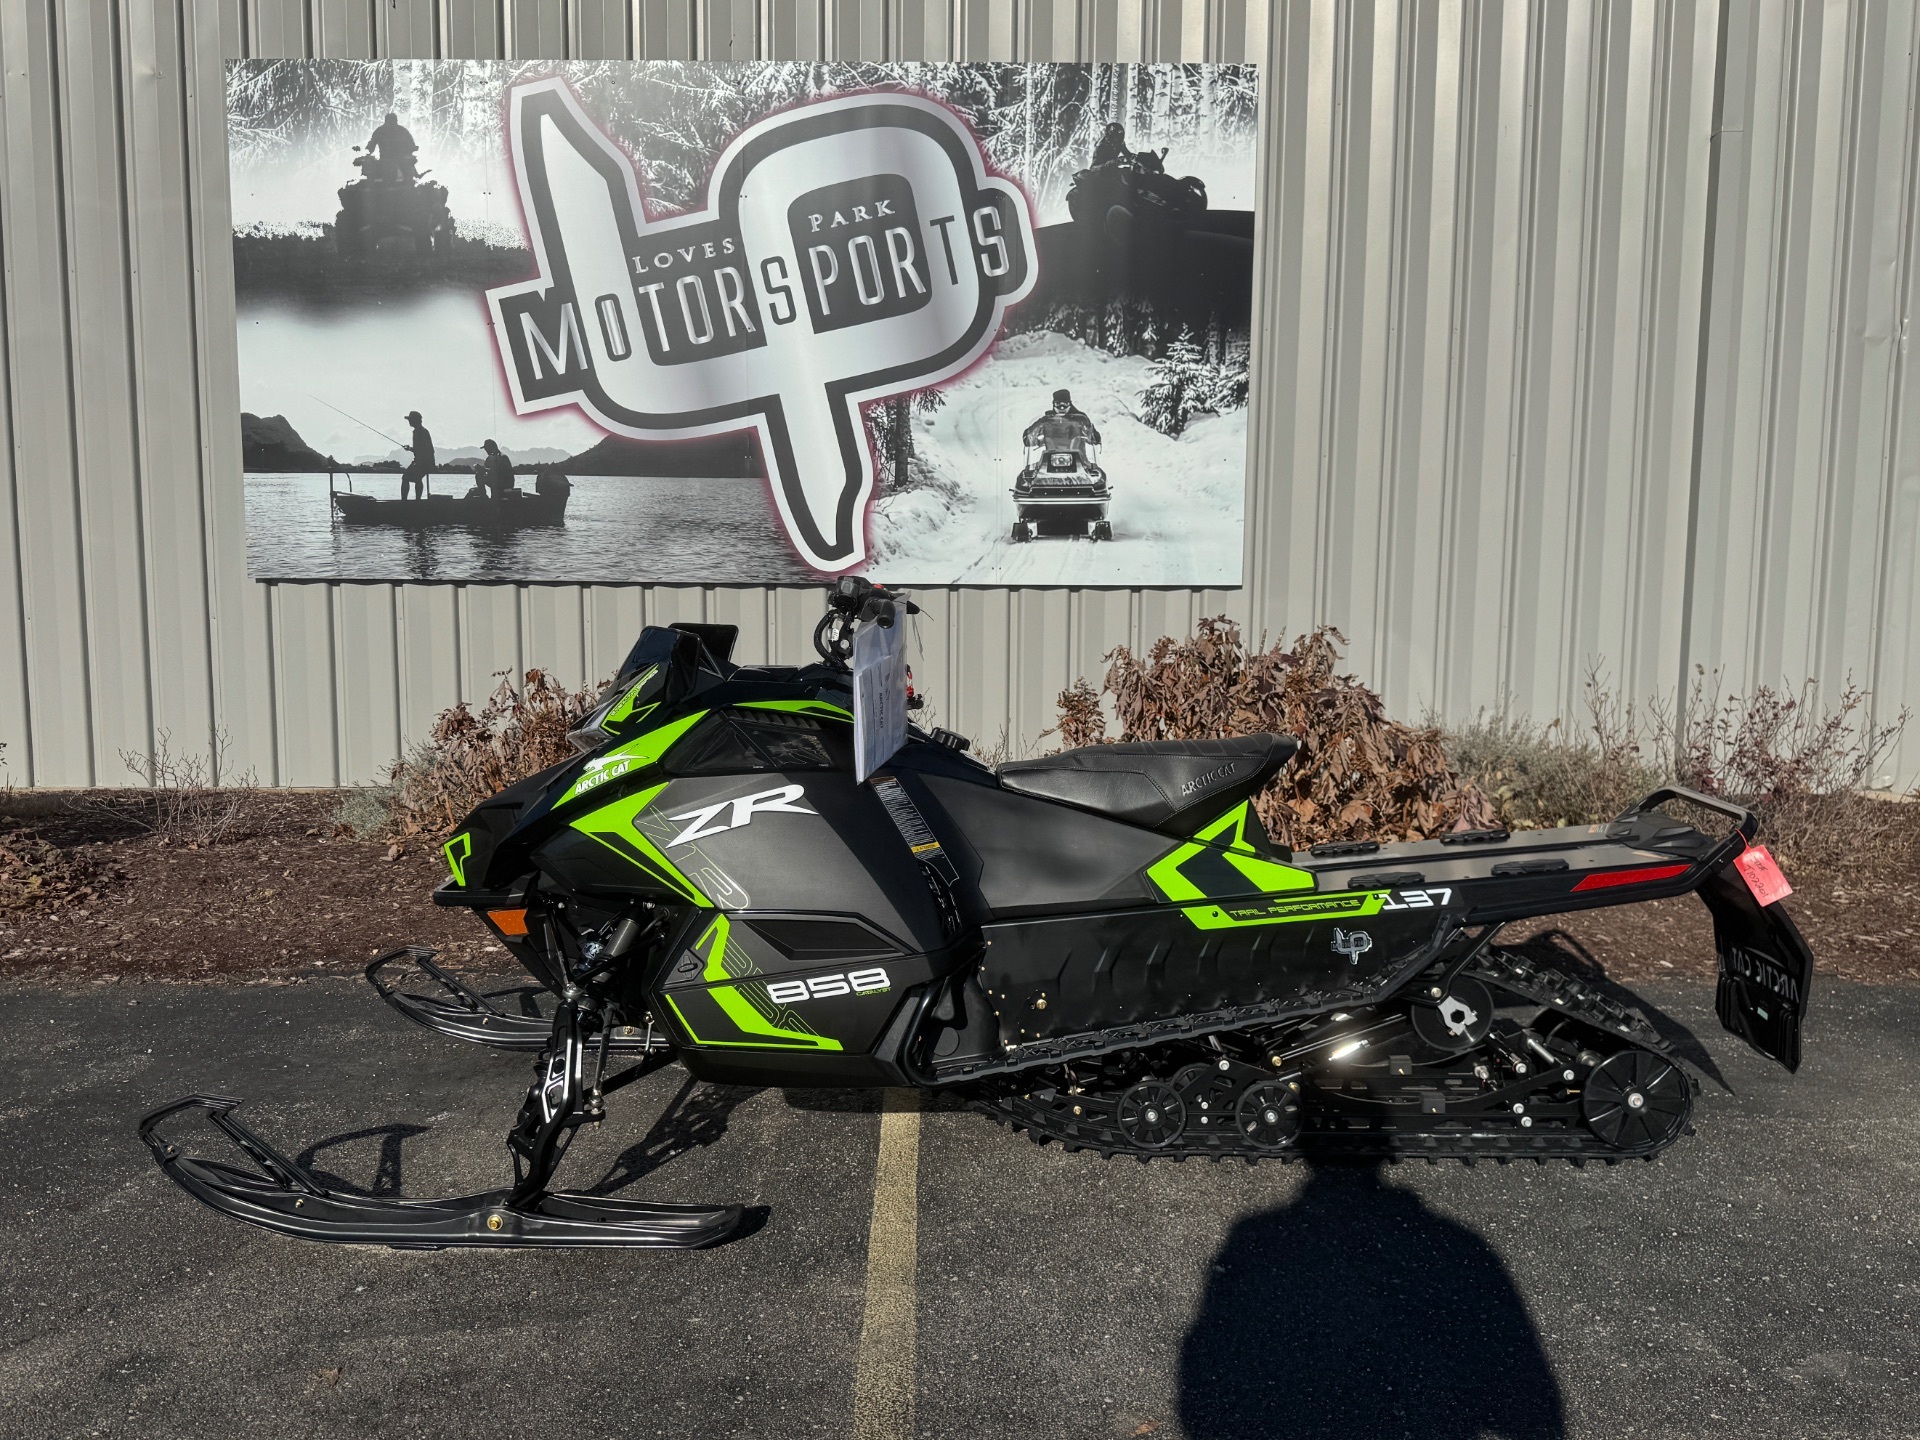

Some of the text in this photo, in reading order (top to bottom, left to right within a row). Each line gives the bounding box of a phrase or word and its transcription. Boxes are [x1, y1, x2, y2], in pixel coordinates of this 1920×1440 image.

[632, 199, 897, 275] LOVES PARK
[519, 205, 1010, 381] MOTORSPORTS
[574, 759, 631, 797] ARCTIC CAT
[1181, 762, 1236, 797] ARCTIC CAT
[665, 784, 820, 849] ZR
[1229, 899, 1361, 917] TRAIL PERFORMANCE
[1378, 887, 1452, 911] 137
[766, 967, 891, 1004] 858
[856, 986, 892, 997] CATALYST
